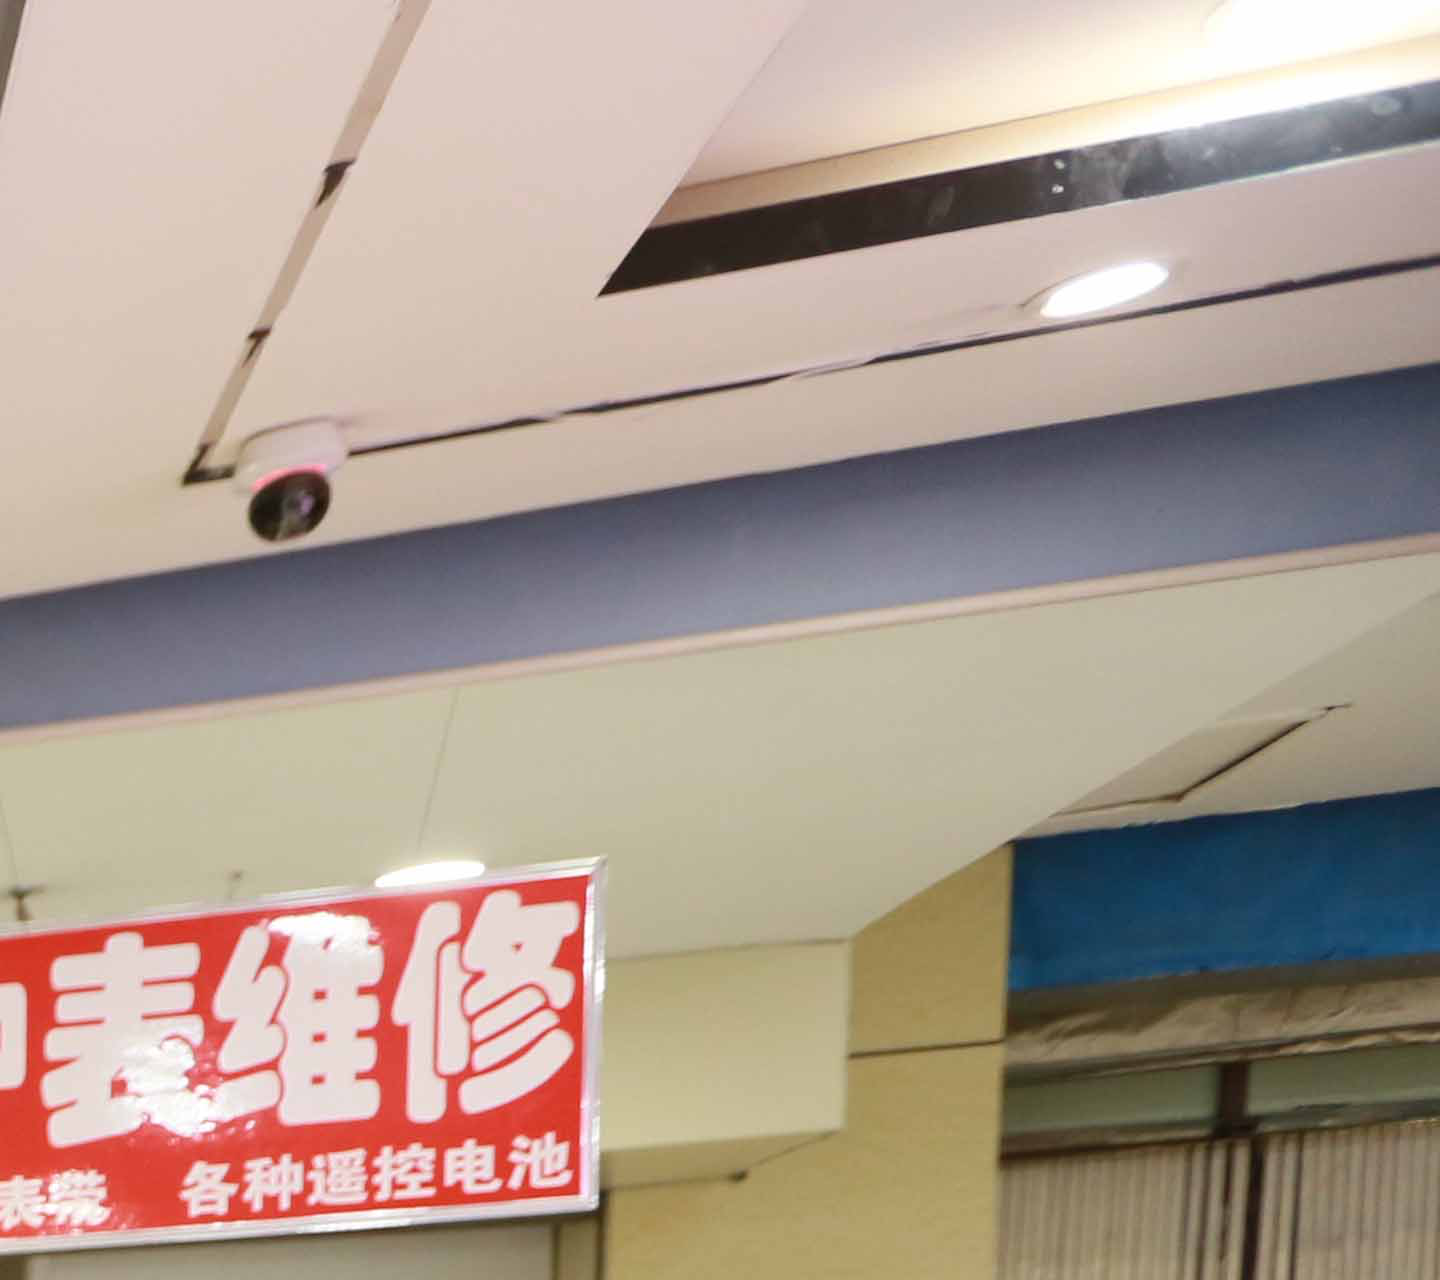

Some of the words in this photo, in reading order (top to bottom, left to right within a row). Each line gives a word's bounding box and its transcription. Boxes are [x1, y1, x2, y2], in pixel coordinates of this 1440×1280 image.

[180, 1132, 573, 1217] 各种遥控电池
